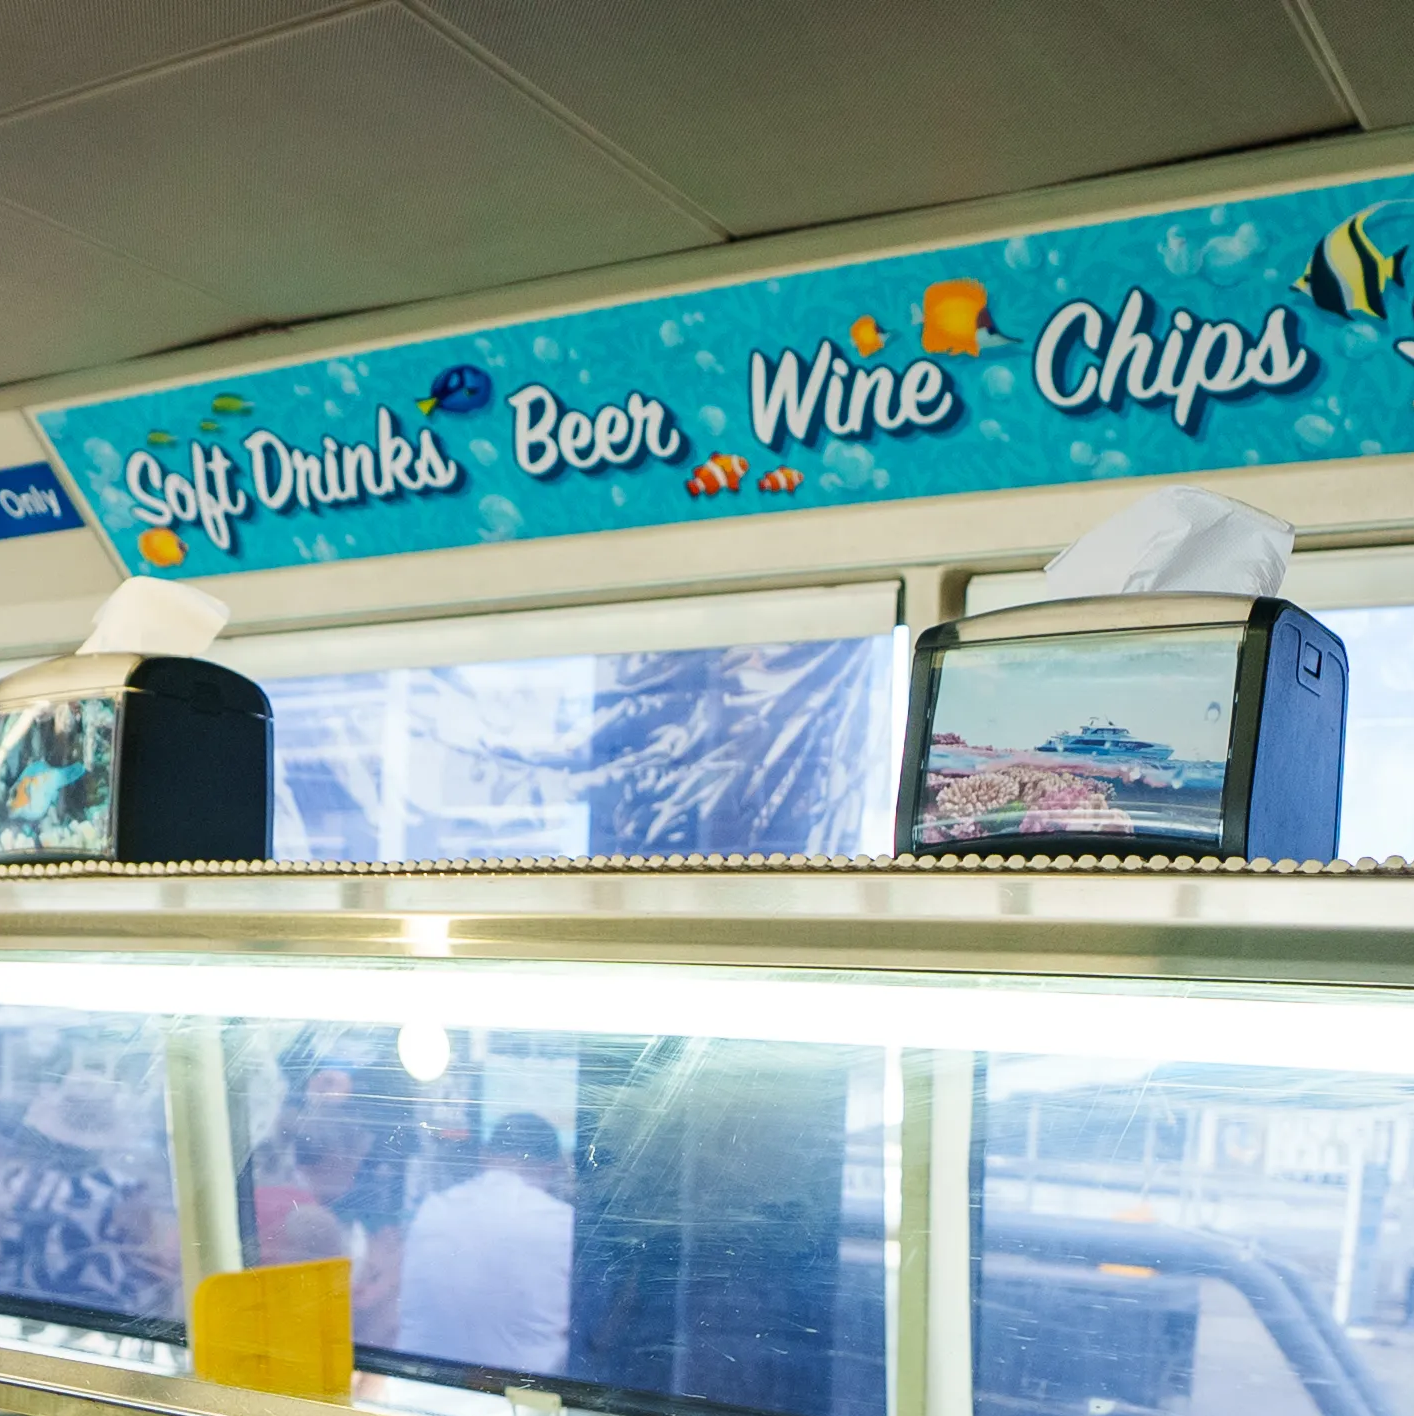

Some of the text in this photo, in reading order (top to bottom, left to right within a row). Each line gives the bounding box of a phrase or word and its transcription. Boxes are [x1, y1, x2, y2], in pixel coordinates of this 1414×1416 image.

[126, 443, 246, 550] Soft
[246, 407, 459, 509] Drinks
[508, 386, 680, 475] Beer
[748, 338, 954, 445] Wine
[1034, 289, 1309, 427] Chips
